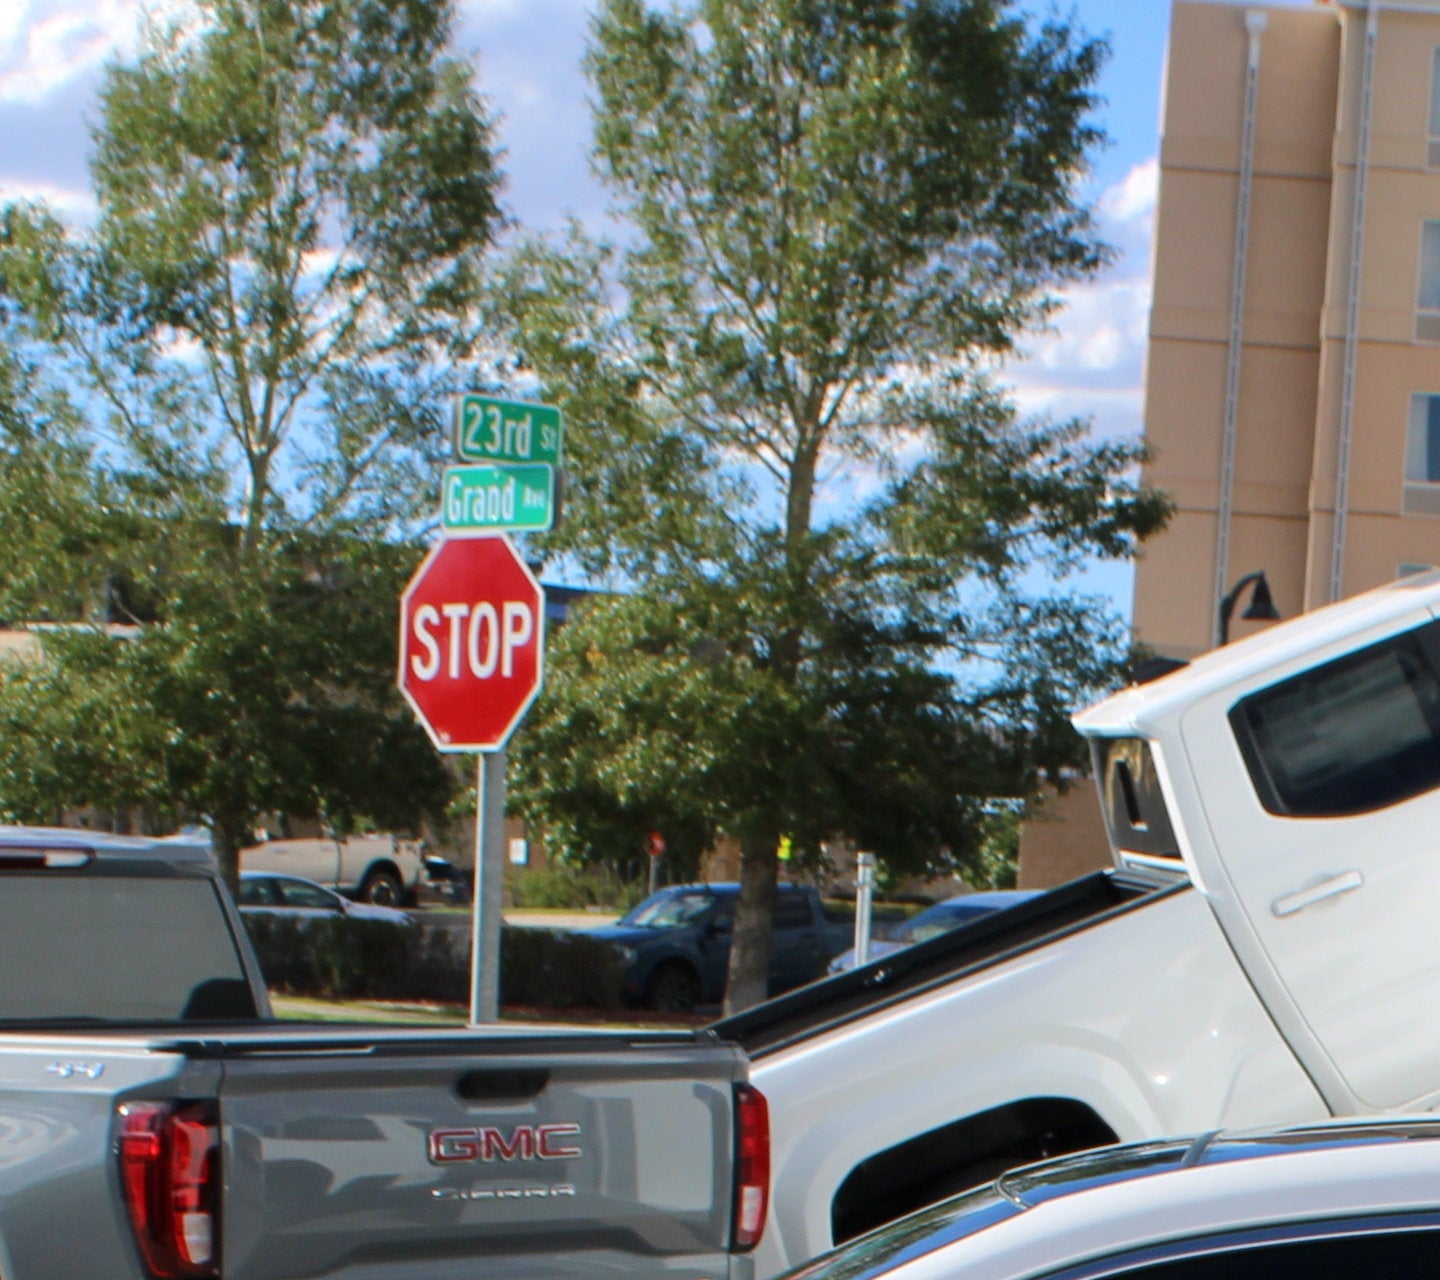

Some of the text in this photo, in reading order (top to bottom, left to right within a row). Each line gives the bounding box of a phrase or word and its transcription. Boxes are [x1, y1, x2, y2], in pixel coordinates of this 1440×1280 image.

[465, 403, 532, 459] 23rd
[448, 476, 515, 523] Grand
[411, 601, 533, 681] STOP
[429, 1123, 582, 1164] GMC
